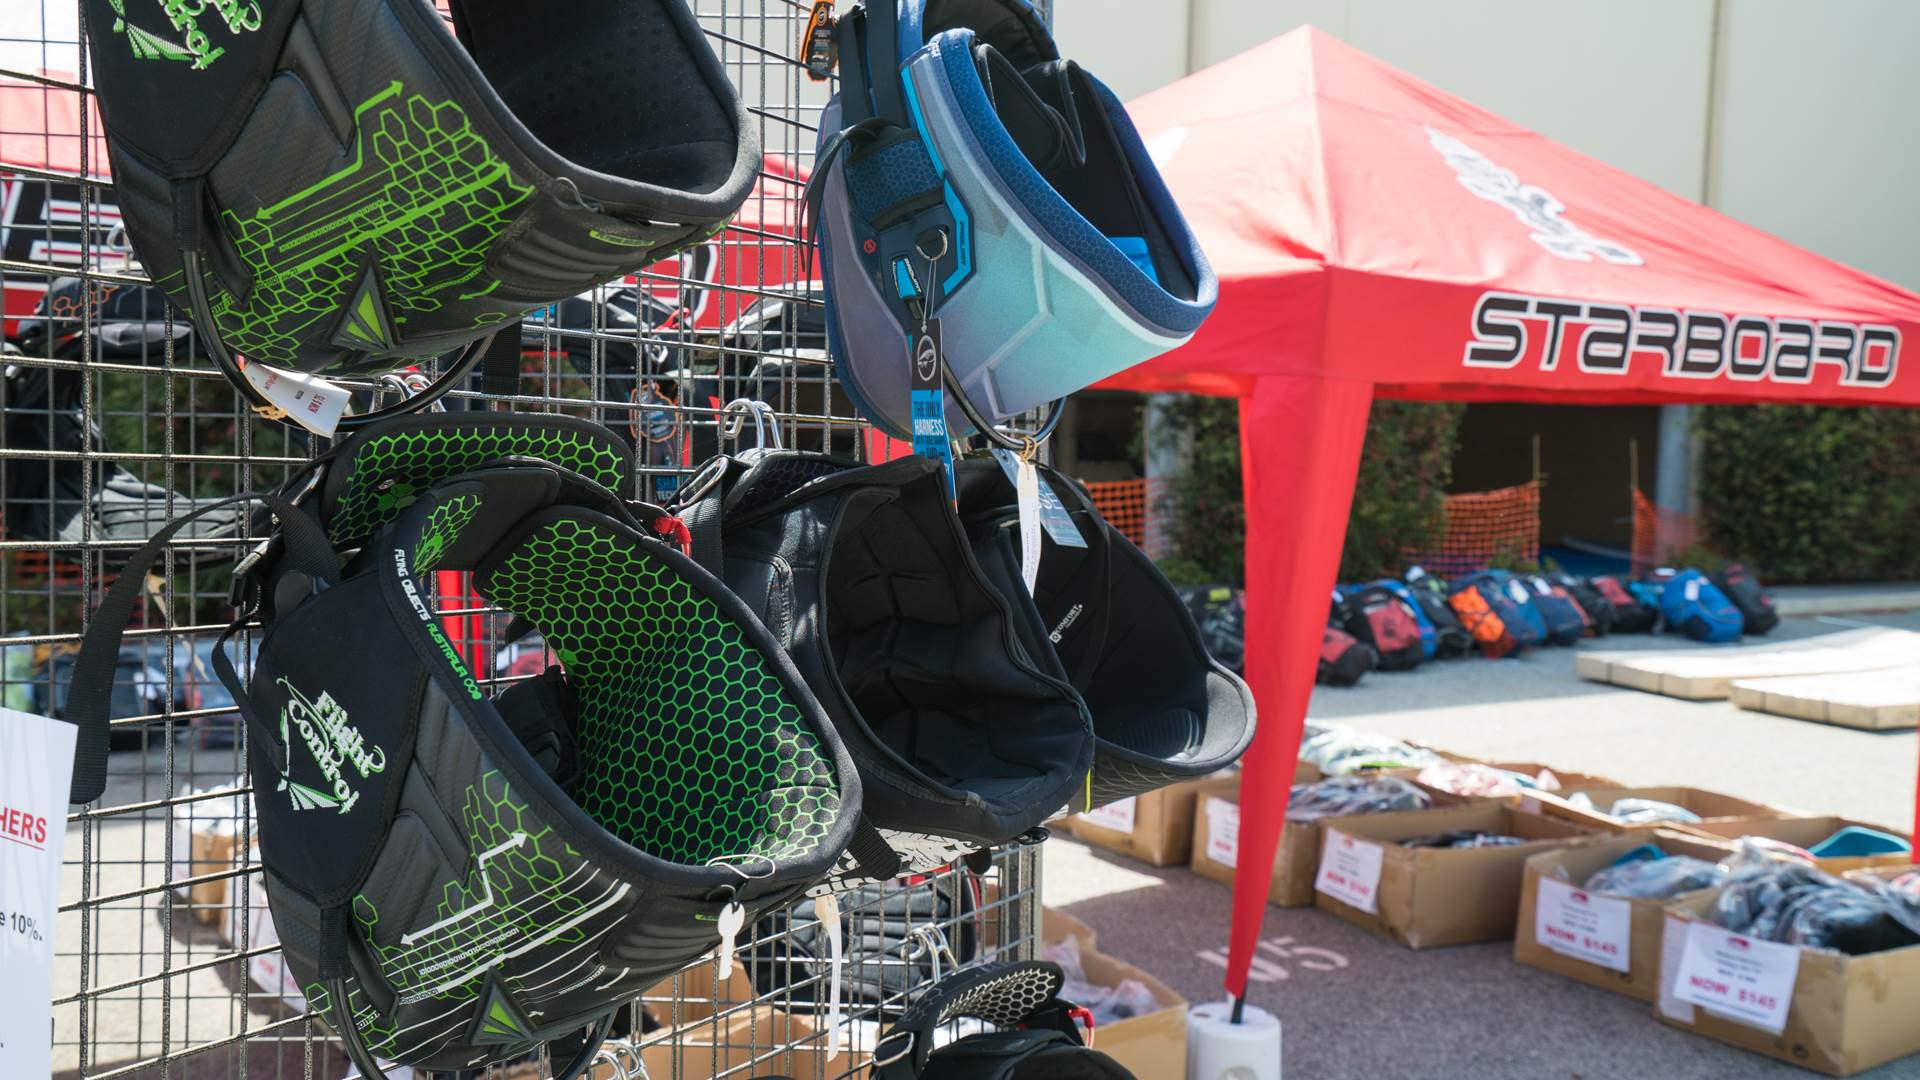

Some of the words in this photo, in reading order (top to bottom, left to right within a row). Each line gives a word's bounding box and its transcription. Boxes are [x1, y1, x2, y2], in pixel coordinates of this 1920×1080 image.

[1463, 291, 1902, 388] STARBOARD
[913, 401, 925, 417] THE
[925, 401, 941, 417] ONLY
[914, 418, 945, 436] HARNESS
[394, 548, 409, 577] FLYING
[401, 578, 432, 621] OBJECTS
[426, 622, 469, 678] AUSTRALIA
[312, 690, 386, 779] Flight
[287, 698, 361, 815] Control
[1689, 975, 1730, 995] NOW
